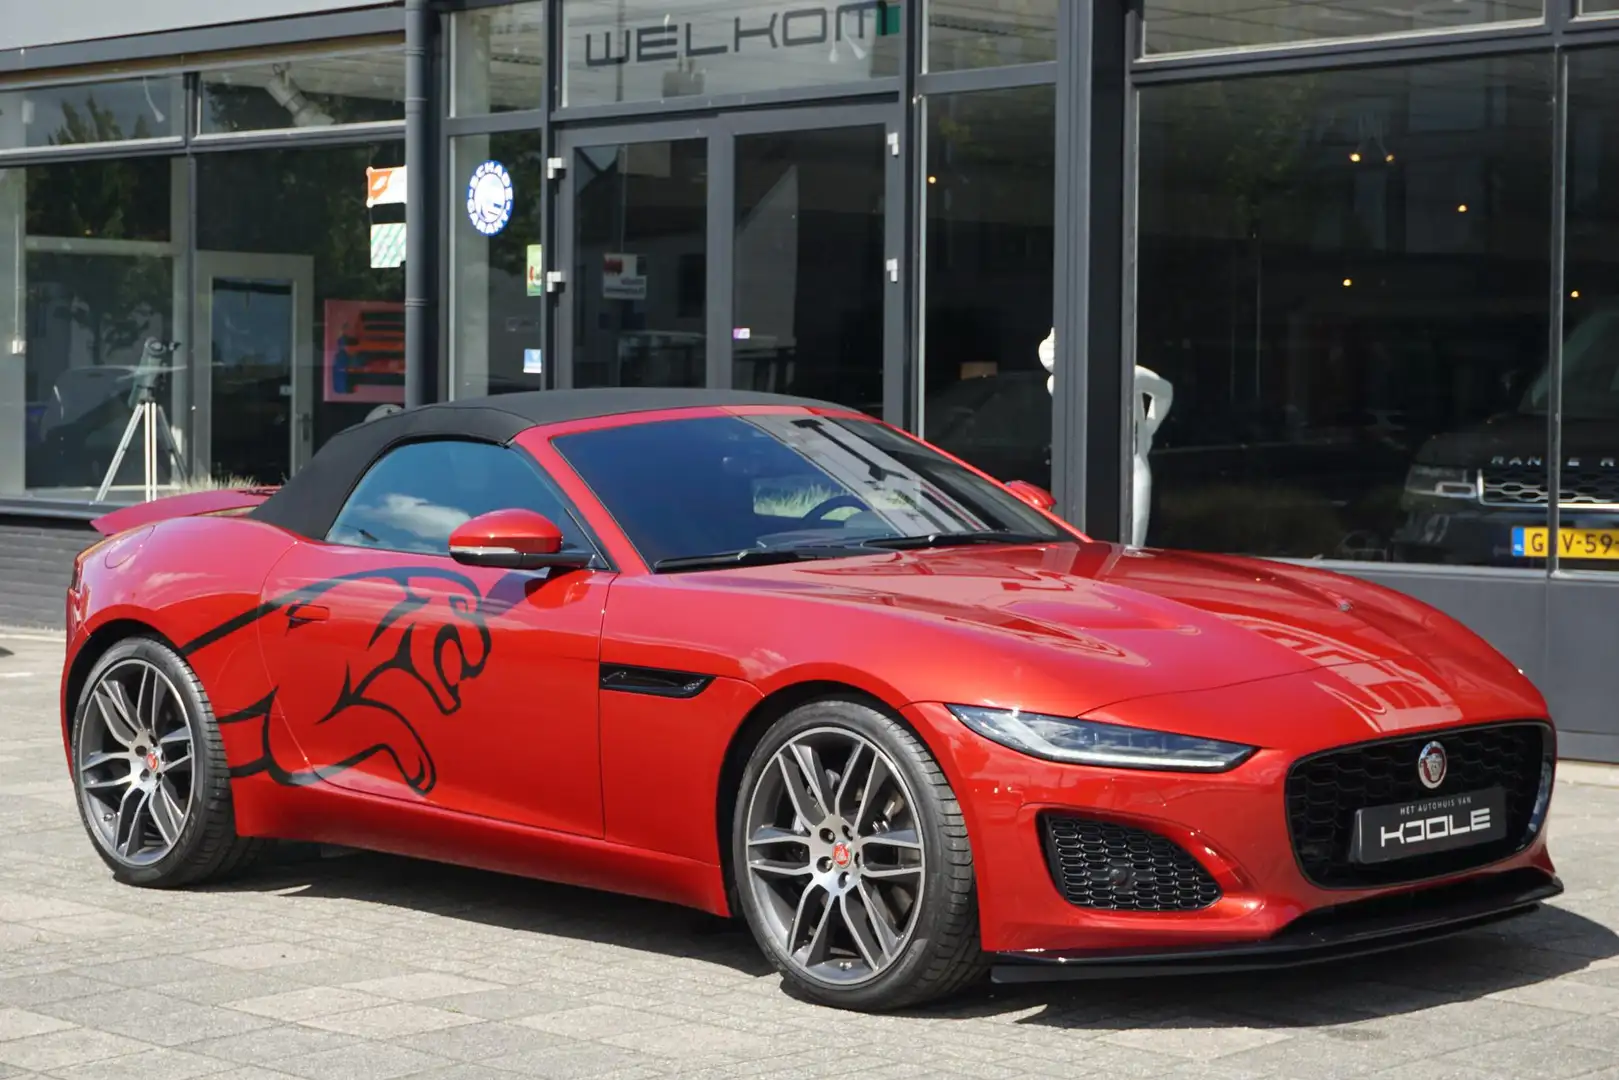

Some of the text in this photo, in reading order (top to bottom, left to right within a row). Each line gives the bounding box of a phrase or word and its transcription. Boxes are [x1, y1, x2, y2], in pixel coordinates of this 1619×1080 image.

[586, 0, 888, 66] WELKOM
[1490, 456, 1580, 467] RANE
[1531, 533, 1619, 554] GV-59-
[1400, 796, 1472, 816] HET AUTOHUIS VAN
